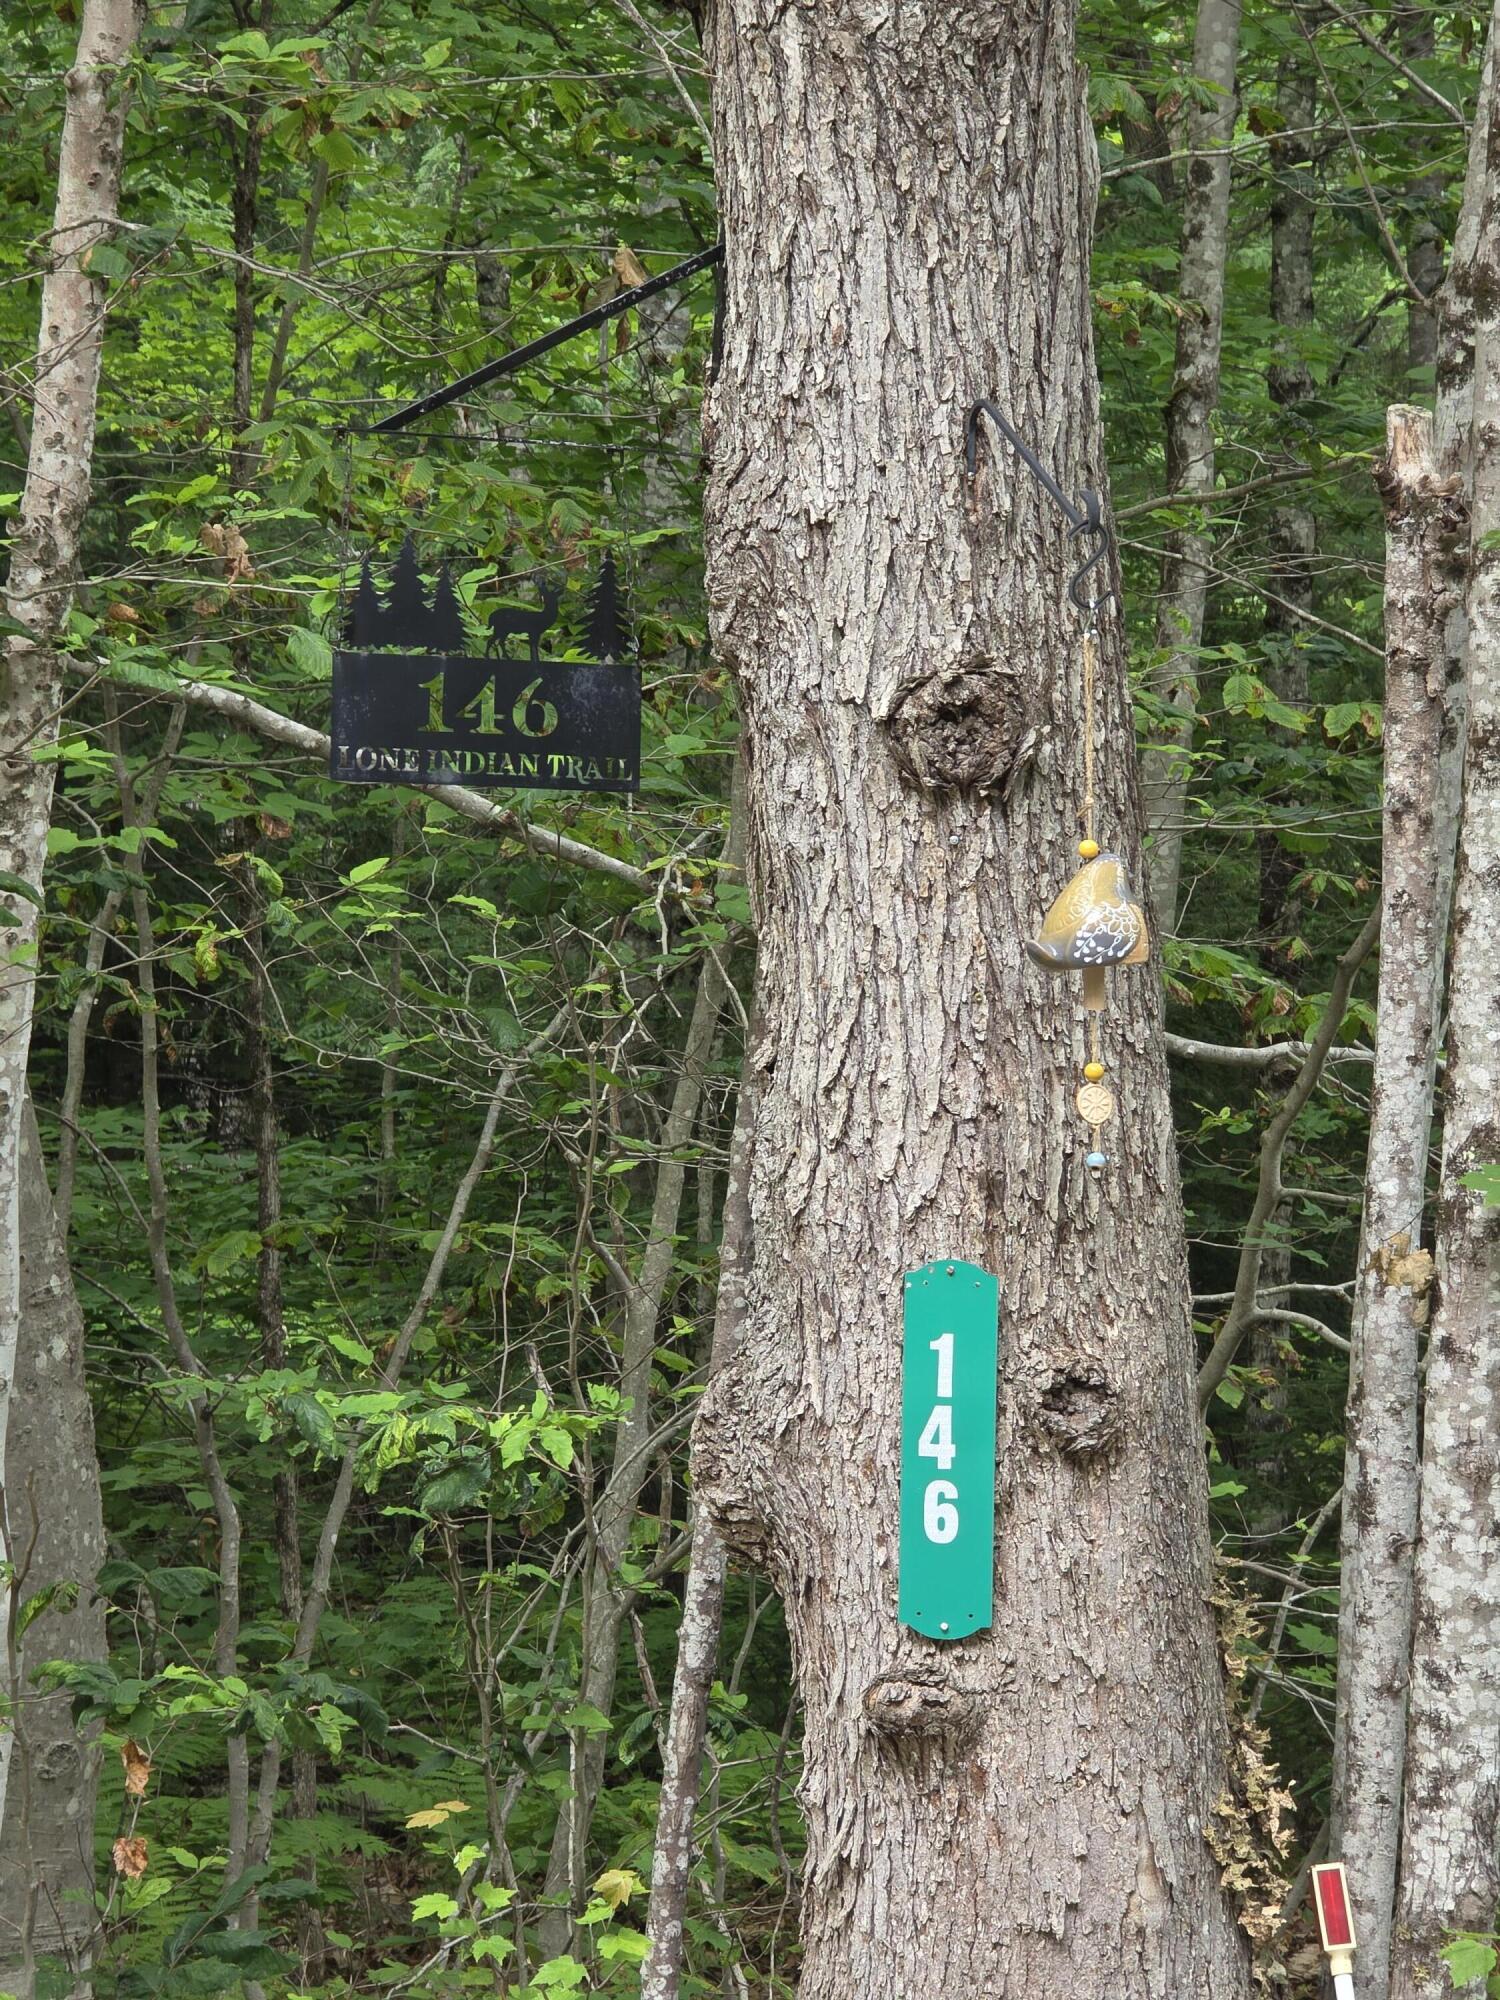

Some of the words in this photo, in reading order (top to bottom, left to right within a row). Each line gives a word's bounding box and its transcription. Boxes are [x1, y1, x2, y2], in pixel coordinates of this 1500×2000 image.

[417, 672, 559, 737] 146
[337, 745, 420, 772] LONE
[427, 749, 539, 777] INDIAN
[547, 754, 633, 784] TRAIL
[918, 1333, 959, 1544] 146
